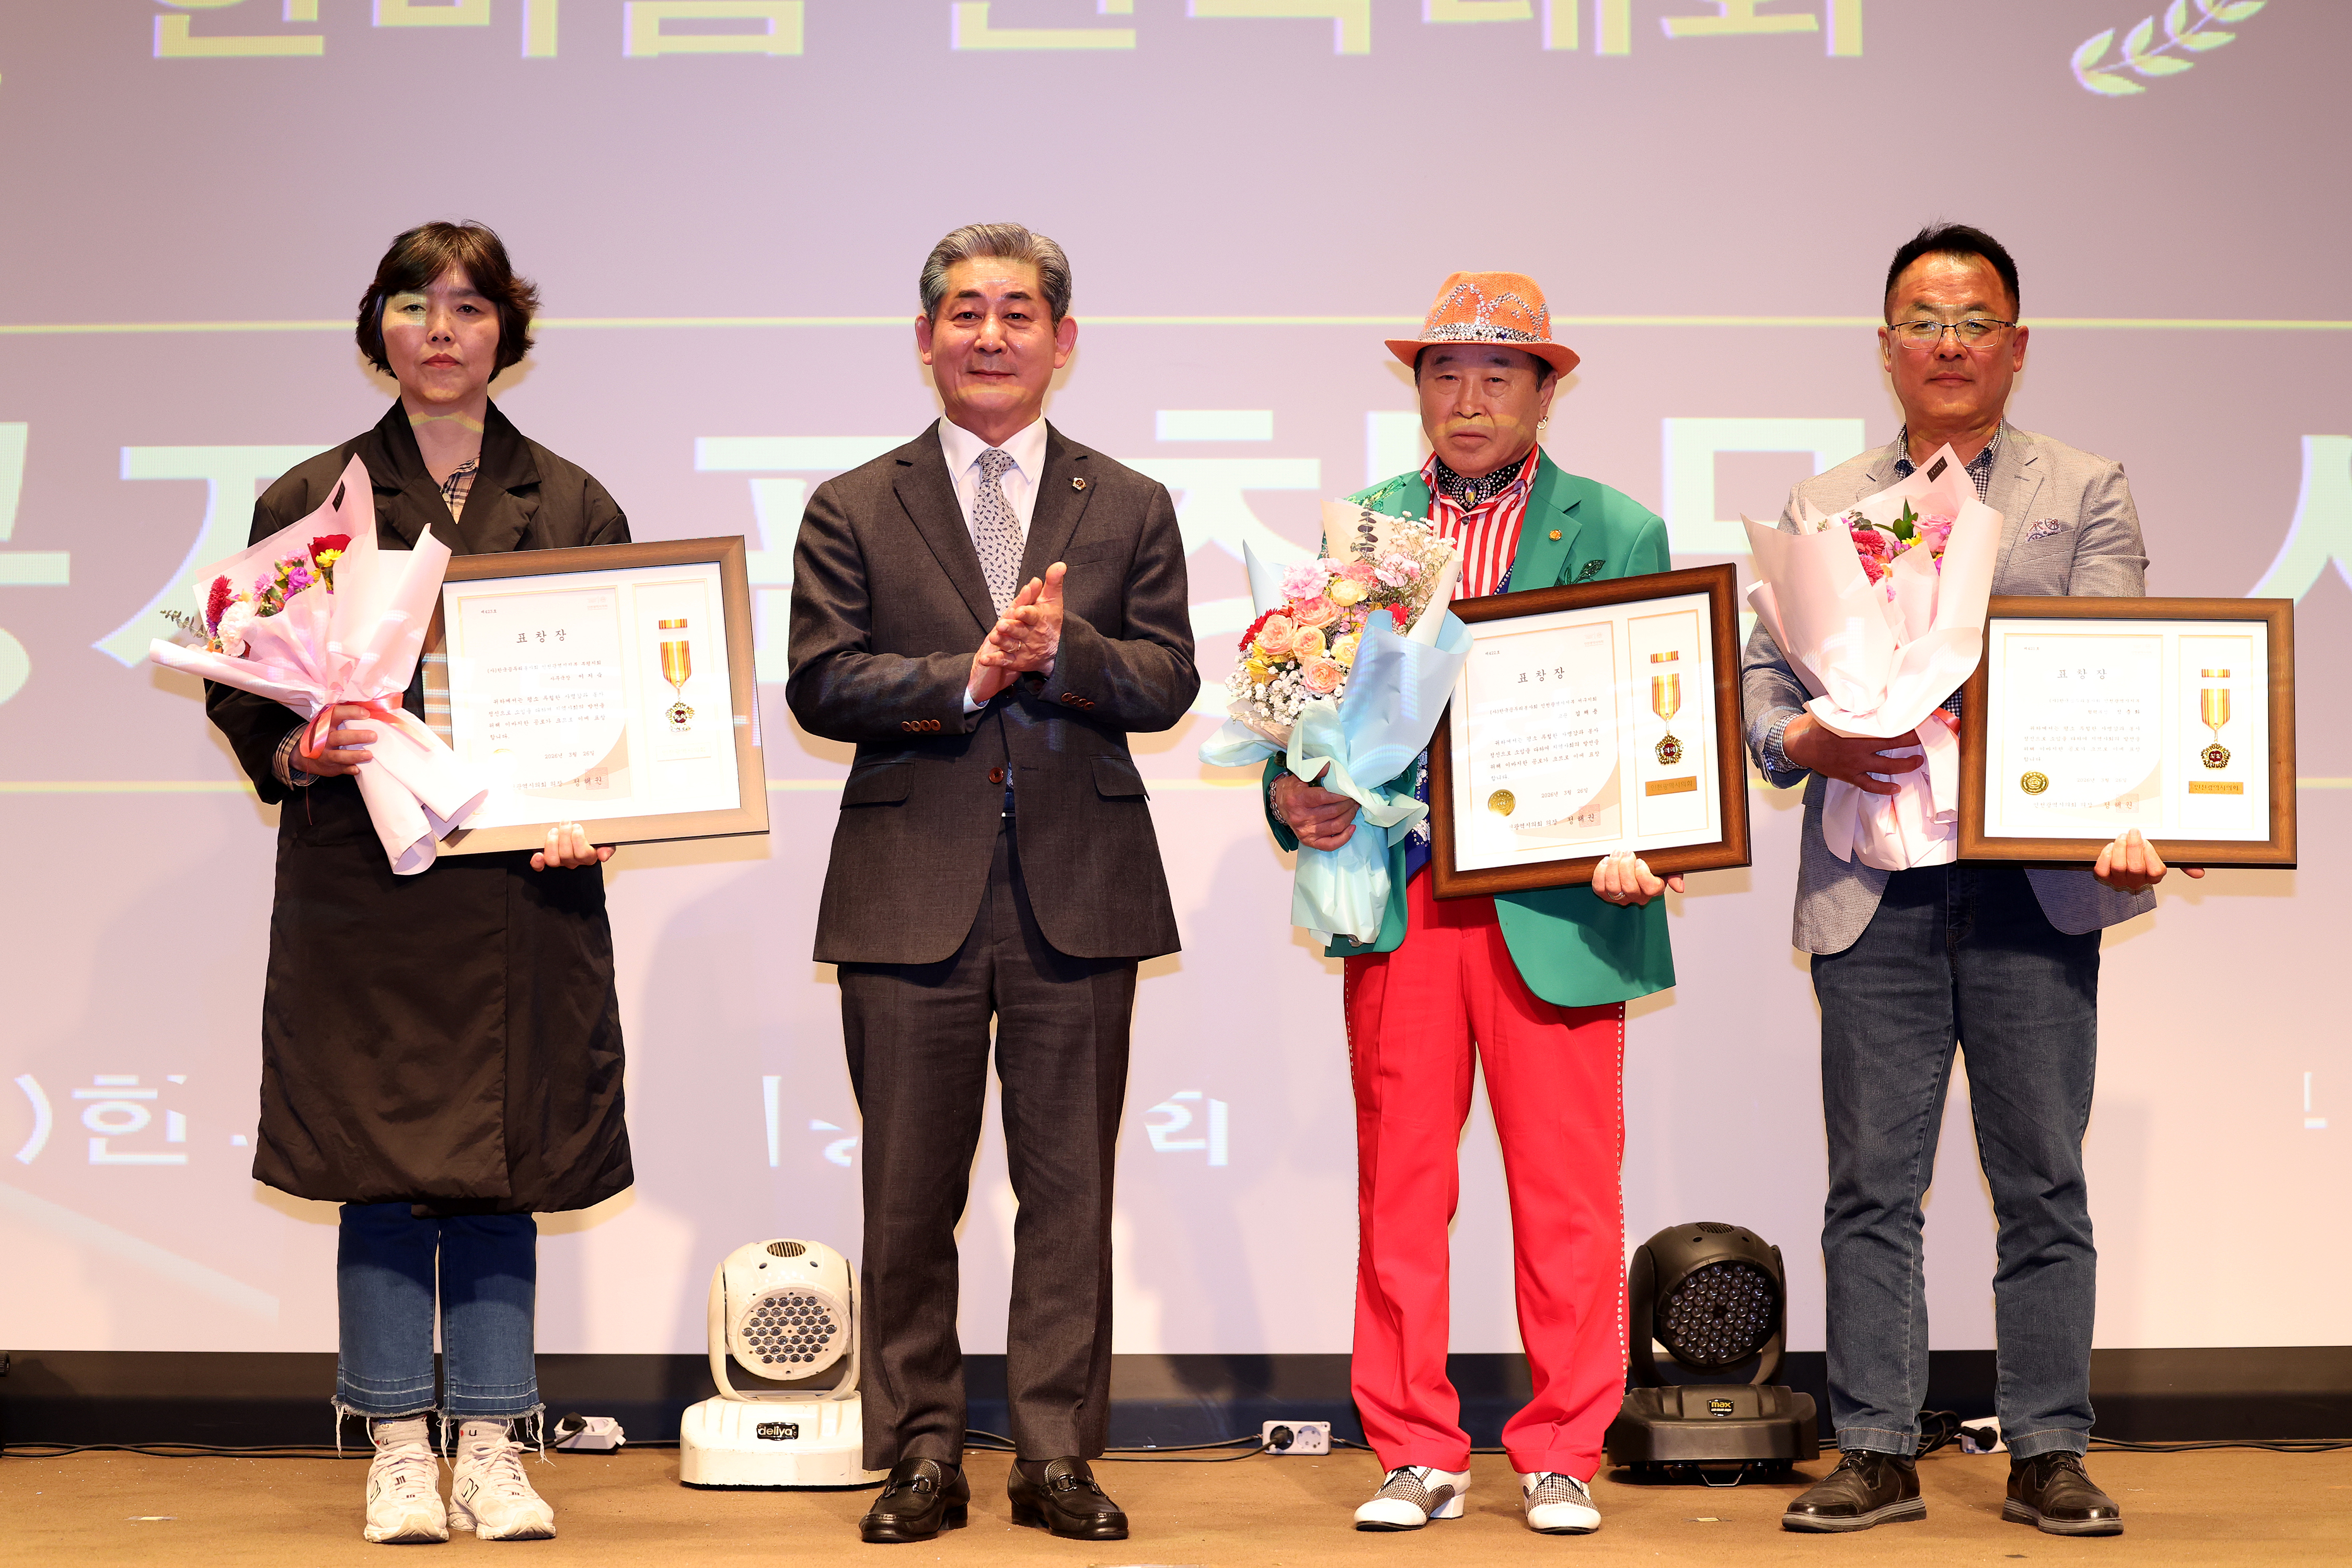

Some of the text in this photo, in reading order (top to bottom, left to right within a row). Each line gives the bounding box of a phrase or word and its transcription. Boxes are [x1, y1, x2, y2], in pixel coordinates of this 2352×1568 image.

[541, 661, 578, 670] 인천광역시지부
[1540, 699, 1575, 709] 인천광역시지부
[505, 719, 529, 728] 이바지한
[1494, 737, 1523, 746] 귀하께서는
[1562, 729, 1584, 737] 사명감과
[1514, 747, 1530, 756] 소임을
[1552, 741, 1579, 750] 지역사회의
[1583, 739, 1599, 747] 발전을
[1505, 759, 1528, 768] 이바지한
[513, 780, 547, 790] 광역시의회
[1651, 780, 1692, 791] 인천광역시의회
[1509, 820, 1542, 831] 광역시의회
[1546, 818, 1558, 827] 의장
[757, 1425, 793, 1437] deliya
[462, 1478, 479, 1504] N
